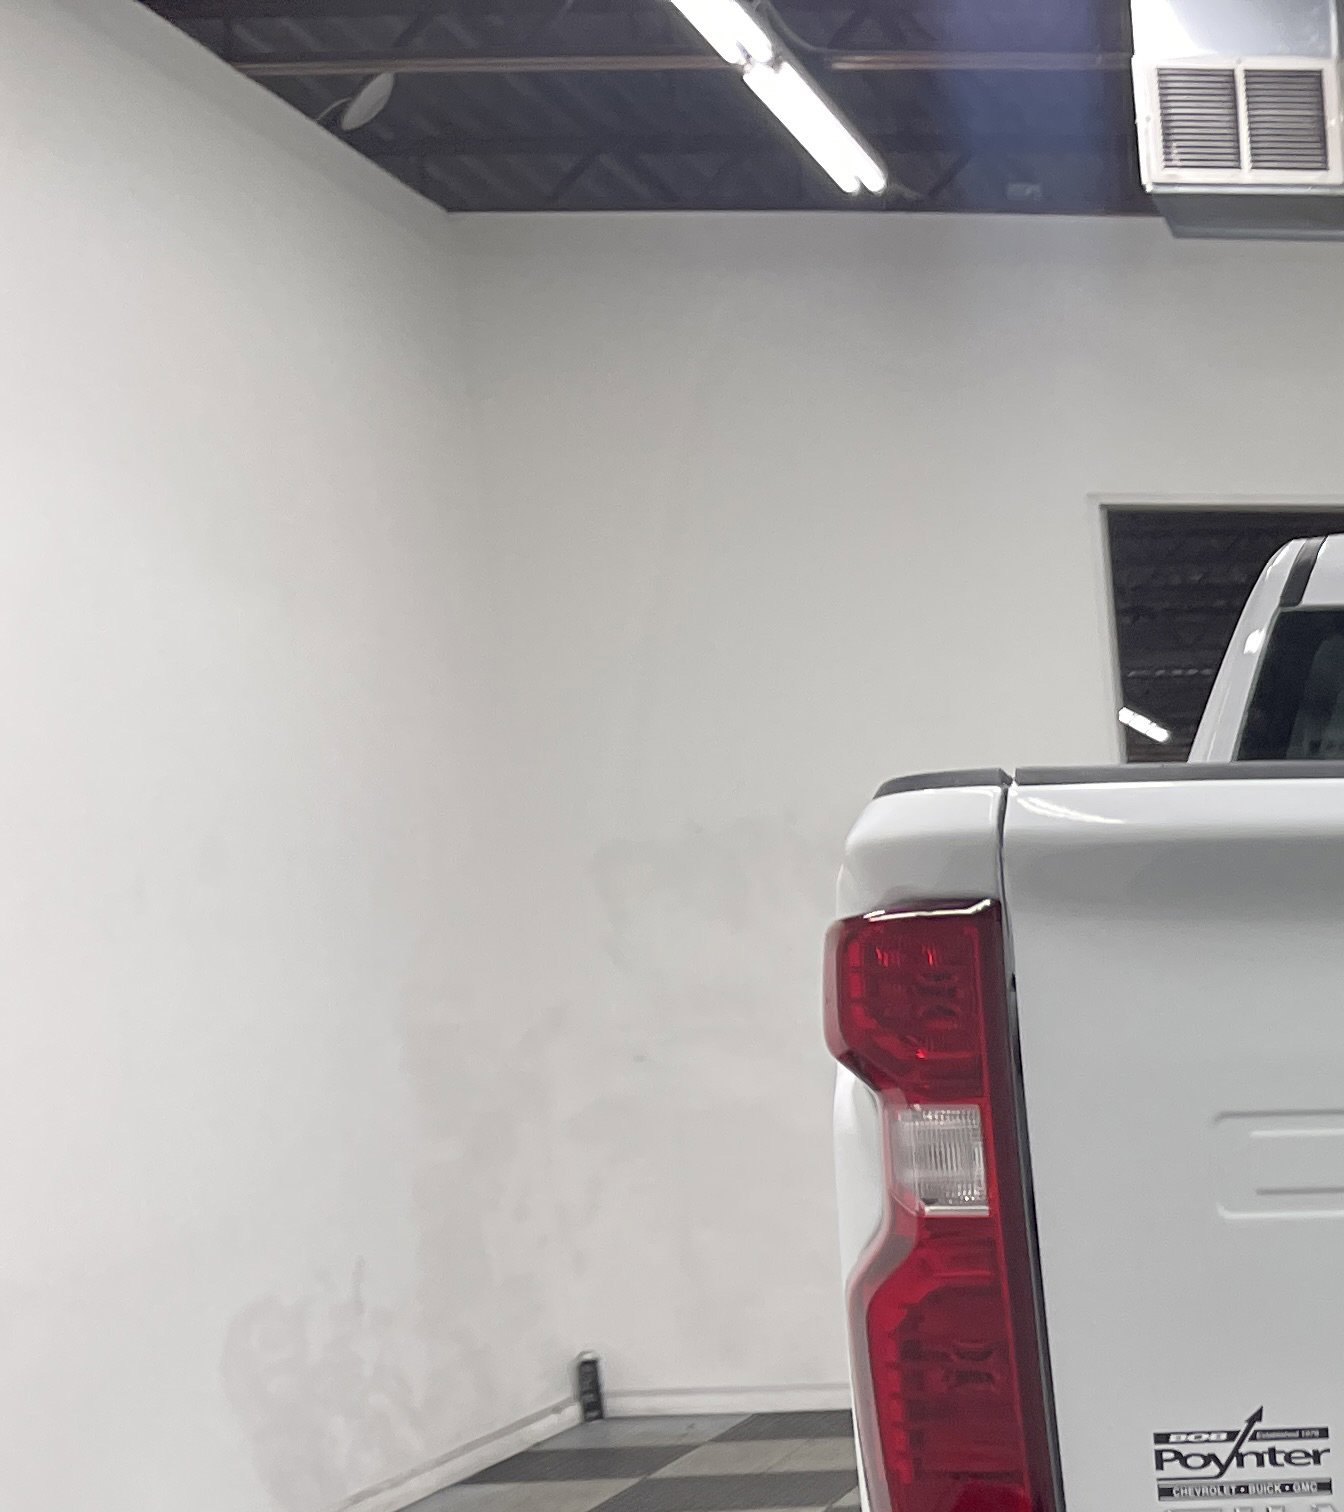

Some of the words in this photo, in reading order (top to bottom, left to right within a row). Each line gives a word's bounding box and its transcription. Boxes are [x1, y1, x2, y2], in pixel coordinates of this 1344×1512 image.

[1169, 1432, 1227, 1443] BOB
[1154, 1446, 1330, 1479] Poynter
[1172, 1485, 1237, 1498] CHEVROLET
[1249, 1483, 1281, 1495] BUICK
[1293, 1481, 1318, 1494] GMC
